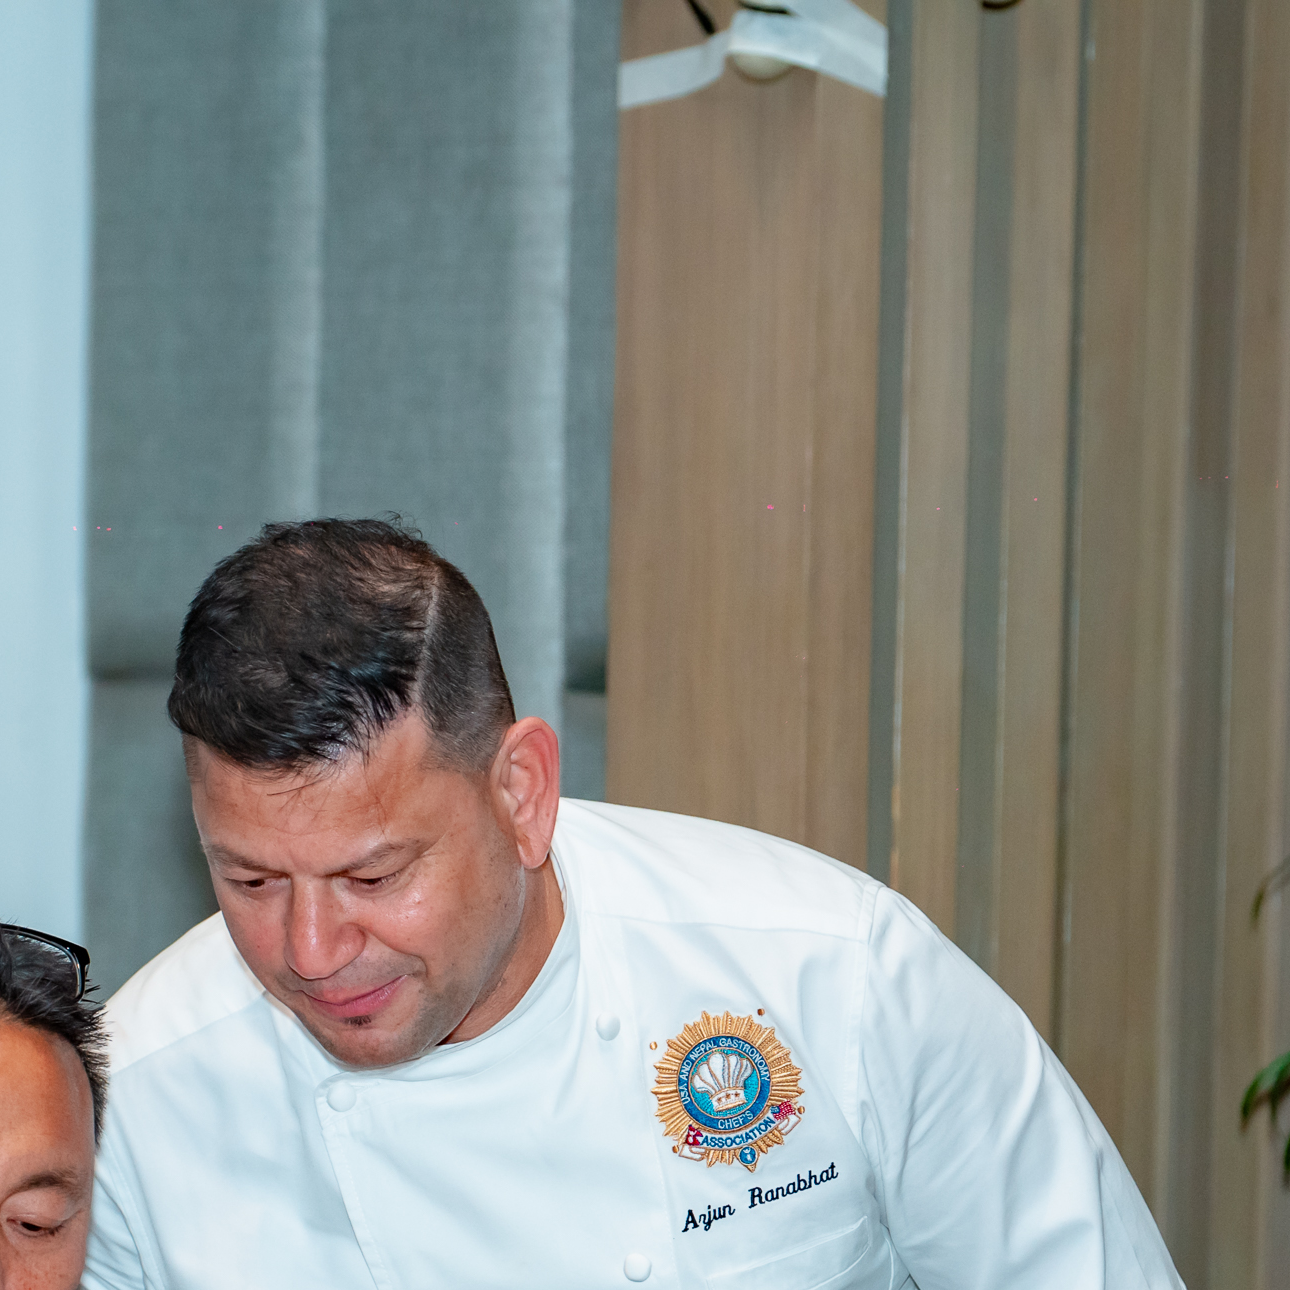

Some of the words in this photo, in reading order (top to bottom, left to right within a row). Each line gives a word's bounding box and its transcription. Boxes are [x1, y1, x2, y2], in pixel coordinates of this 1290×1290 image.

[689, 1040, 717, 1060] NEPAL
[719, 1037, 770, 1081] GASTRONOMY
[679, 1060, 692, 1080] AND
[679, 1083, 690, 1104] USA
[700, 1116, 776, 1148] ASSOCIATION
[682, 1204, 736, 1233] Arjun
[748, 1162, 839, 1209] Ranabhat
